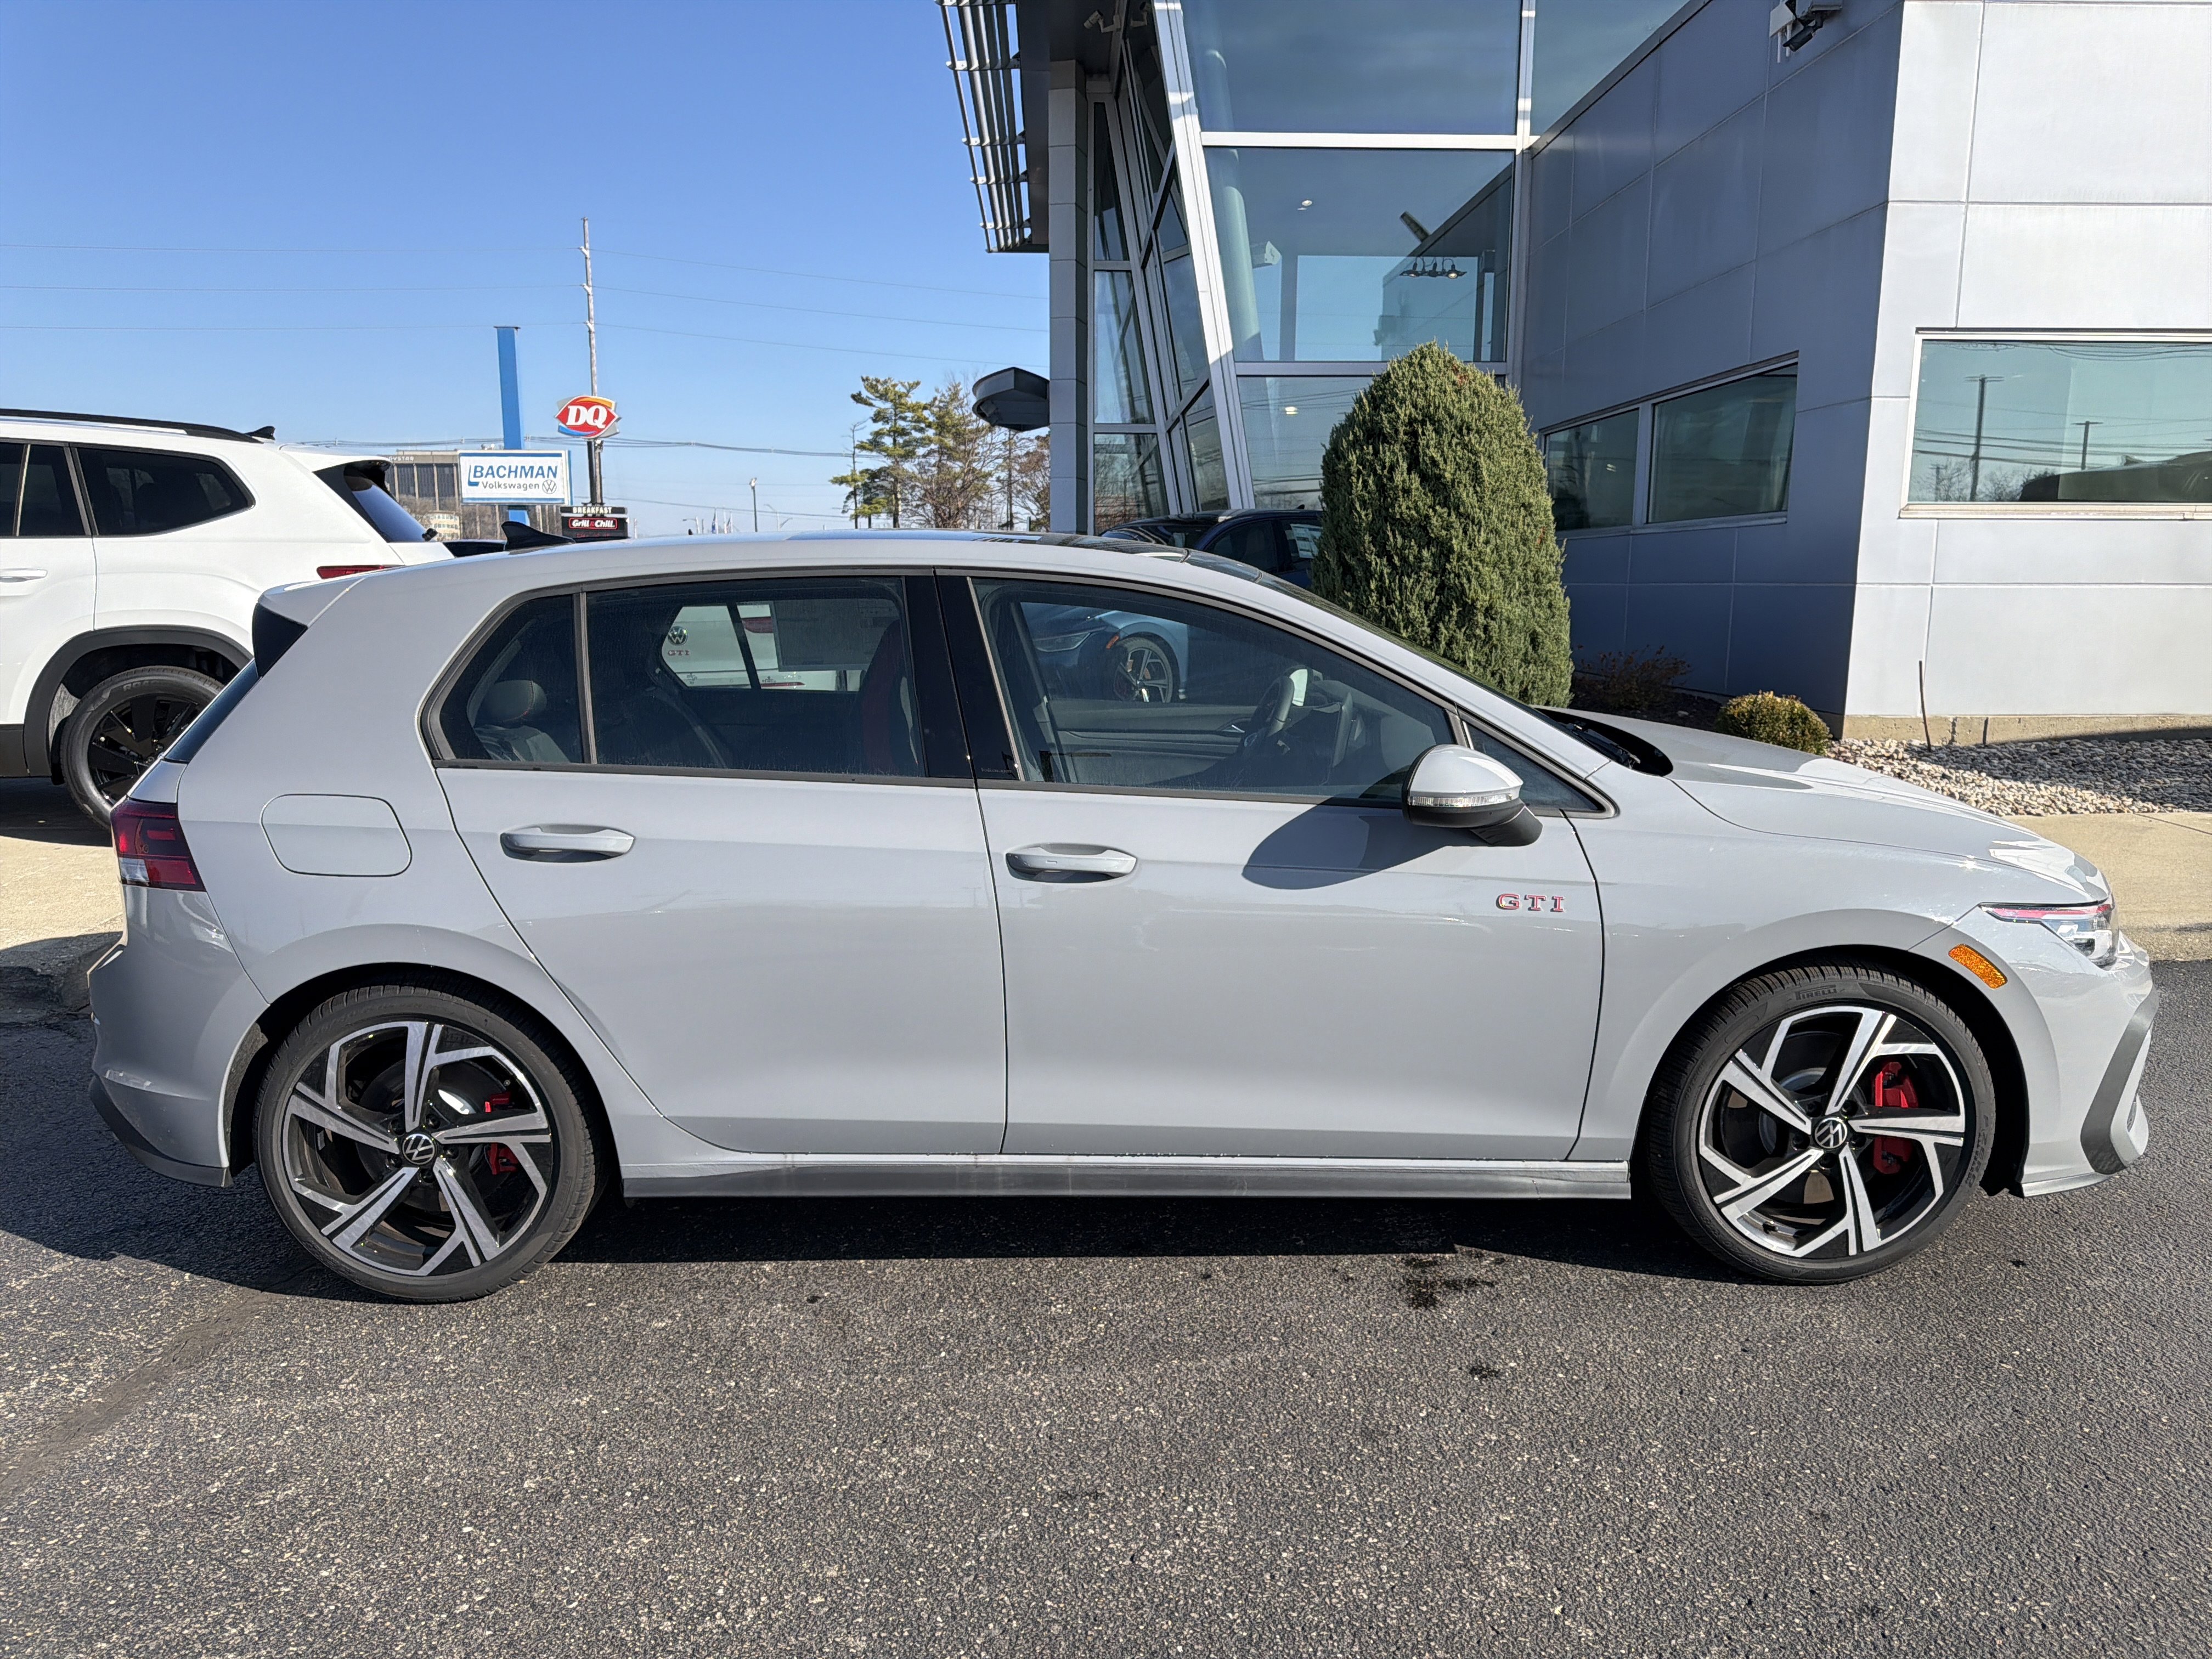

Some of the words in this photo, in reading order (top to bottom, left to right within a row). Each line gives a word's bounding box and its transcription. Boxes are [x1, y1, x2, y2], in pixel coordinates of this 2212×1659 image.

[566, 405, 607, 429] DQ
[473, 465, 558, 479] BACHMAN
[481, 481, 540, 491] Volkswagen
[1496, 893, 1565, 912] GTI
[1795, 985, 1837, 1001] PIRELLI
